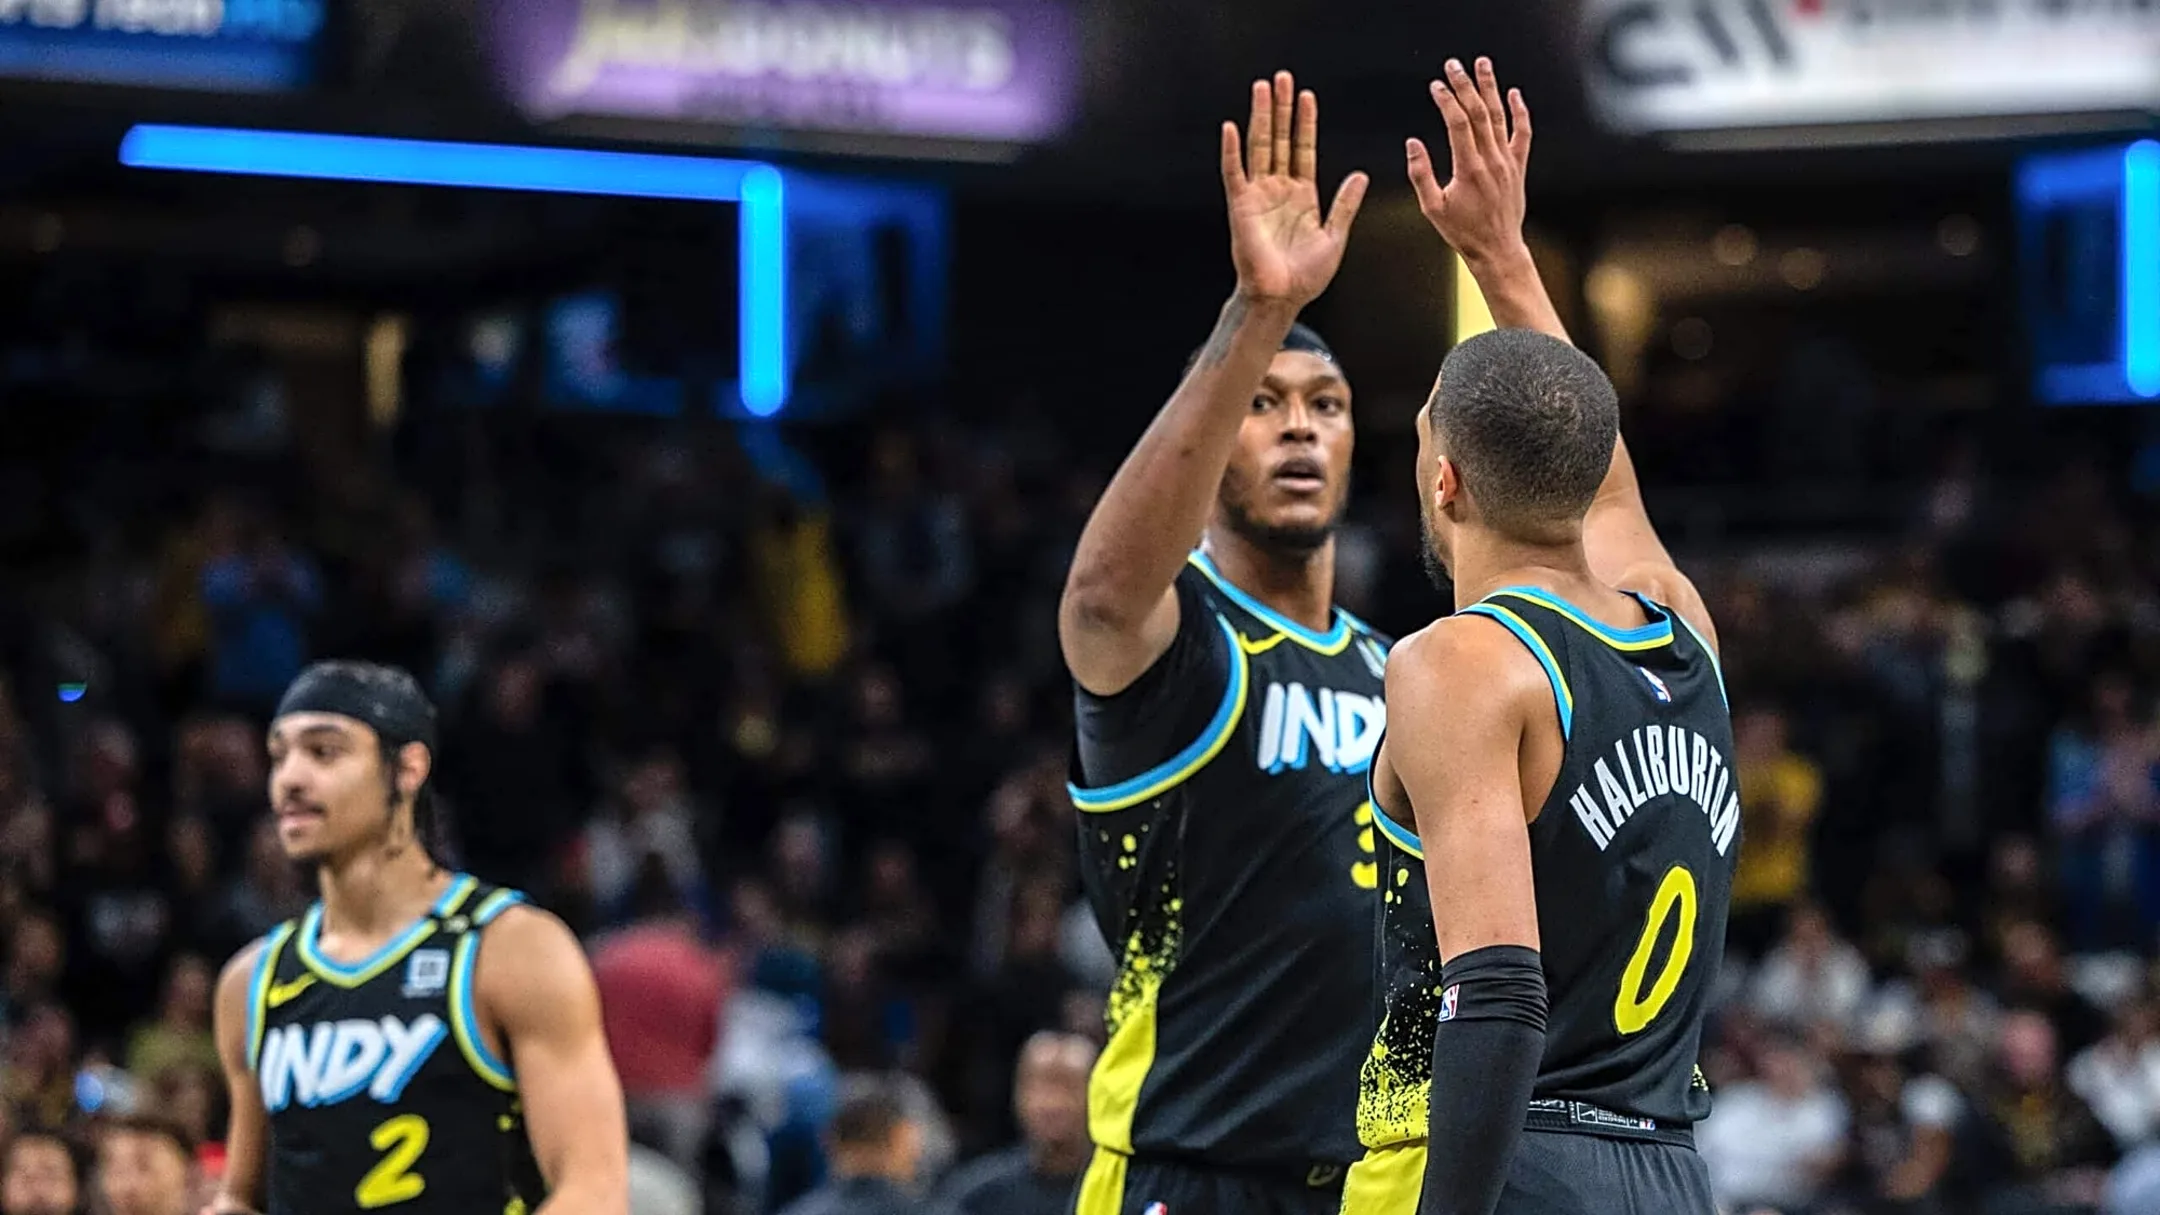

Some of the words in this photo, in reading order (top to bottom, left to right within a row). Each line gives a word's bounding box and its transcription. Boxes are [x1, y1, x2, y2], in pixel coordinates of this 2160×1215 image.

[1257, 681, 1387, 775] IND
[1569, 724, 1741, 857] HALIBURTON
[1614, 865, 1698, 1036] 0
[258, 1013, 450, 1114] INDY
[354, 1114, 431, 1209] 2
